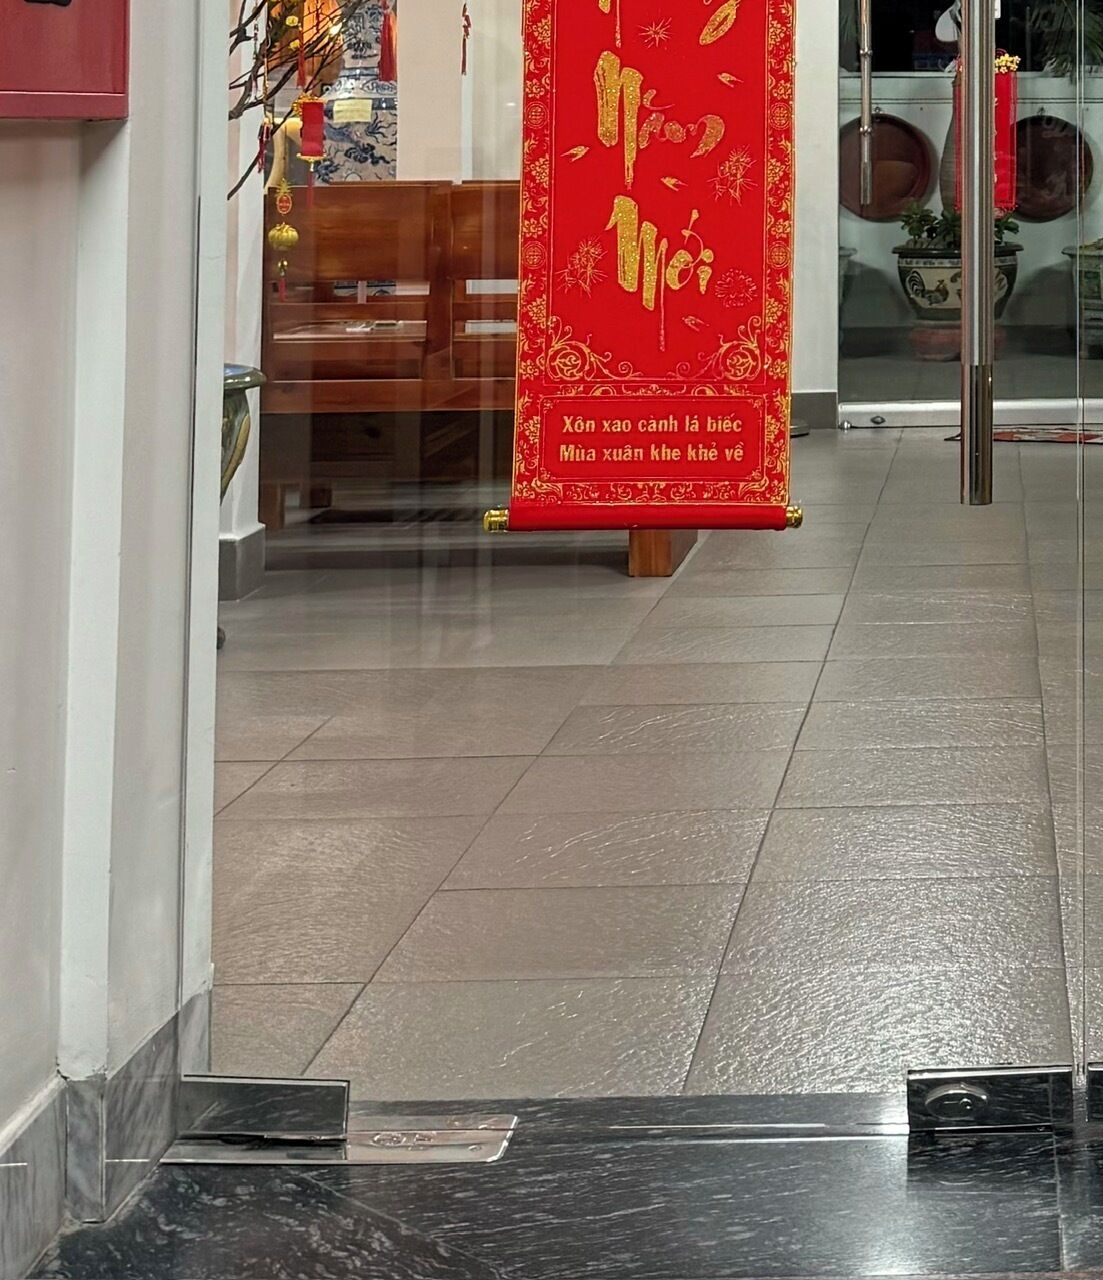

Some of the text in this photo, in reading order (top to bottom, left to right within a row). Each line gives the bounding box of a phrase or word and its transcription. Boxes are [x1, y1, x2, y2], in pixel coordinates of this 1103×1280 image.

[594, 50, 726, 191] Năm
[605, 195, 714, 351] Mới
[559, 444, 596, 462] Mùa
[602, 444, 644, 461] xuân
[650, 444, 681, 461] khe
[725, 441, 745, 461] về
[563, 413, 742, 433] Xôn xao cành lá biếc
